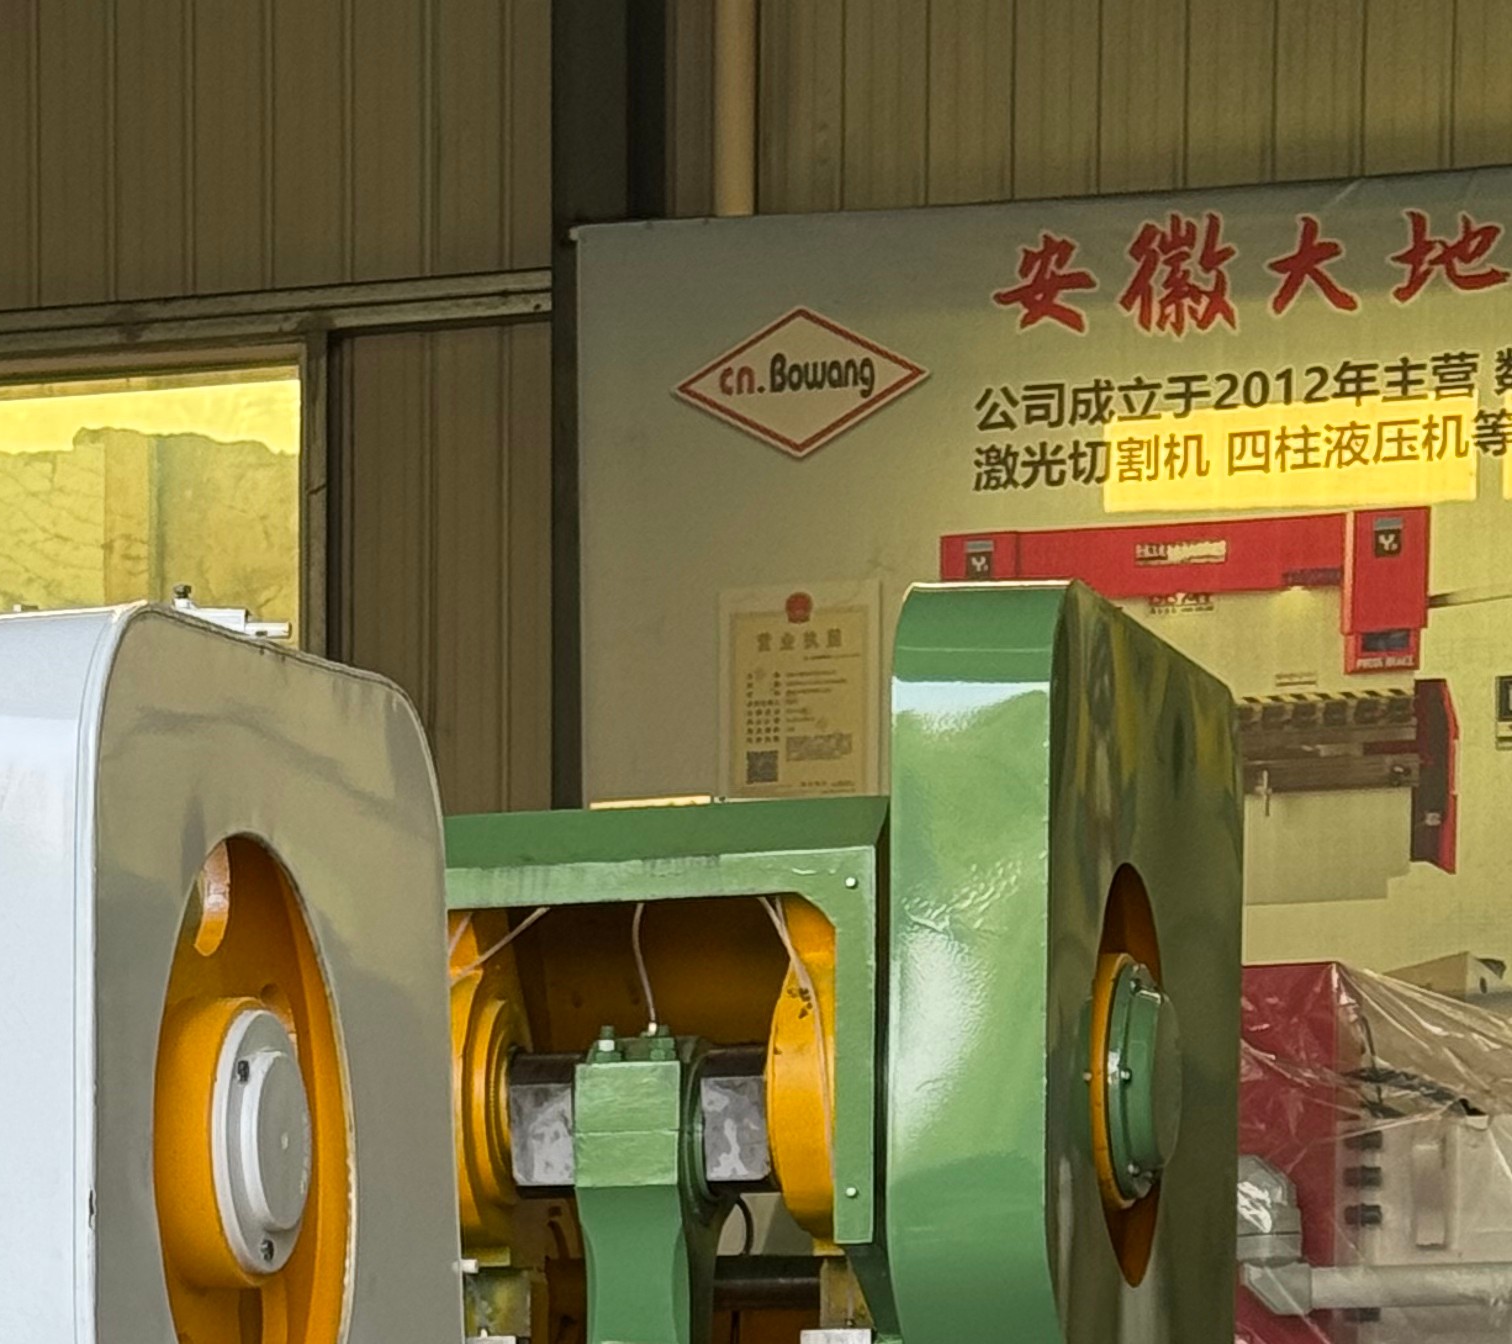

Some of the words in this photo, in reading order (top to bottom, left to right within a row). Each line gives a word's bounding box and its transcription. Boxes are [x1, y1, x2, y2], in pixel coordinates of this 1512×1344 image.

[993, 210, 1511, 337] 安徽大地
[719, 353, 875, 398] cn.Bowang
[975, 351, 1479, 433] 公司成立于2012年主营
[973, 433, 1210, 492] 激光切割机
